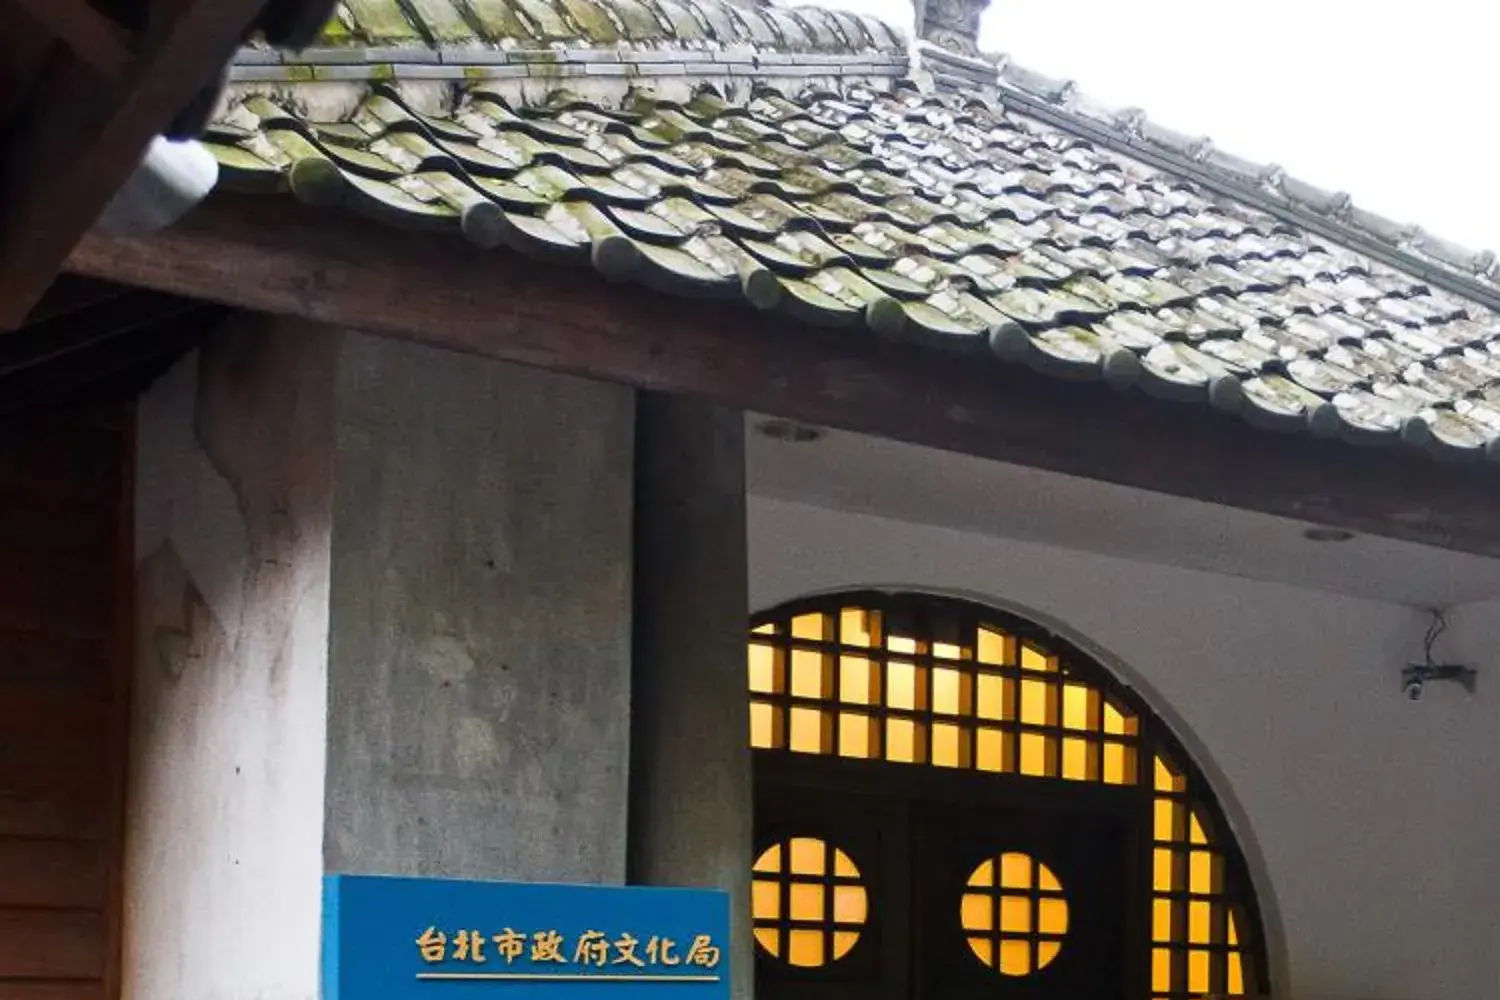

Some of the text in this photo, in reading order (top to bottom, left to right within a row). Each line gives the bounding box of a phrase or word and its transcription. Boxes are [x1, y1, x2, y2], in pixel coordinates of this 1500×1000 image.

[416, 926, 719, 967] 台北市政府文化局
